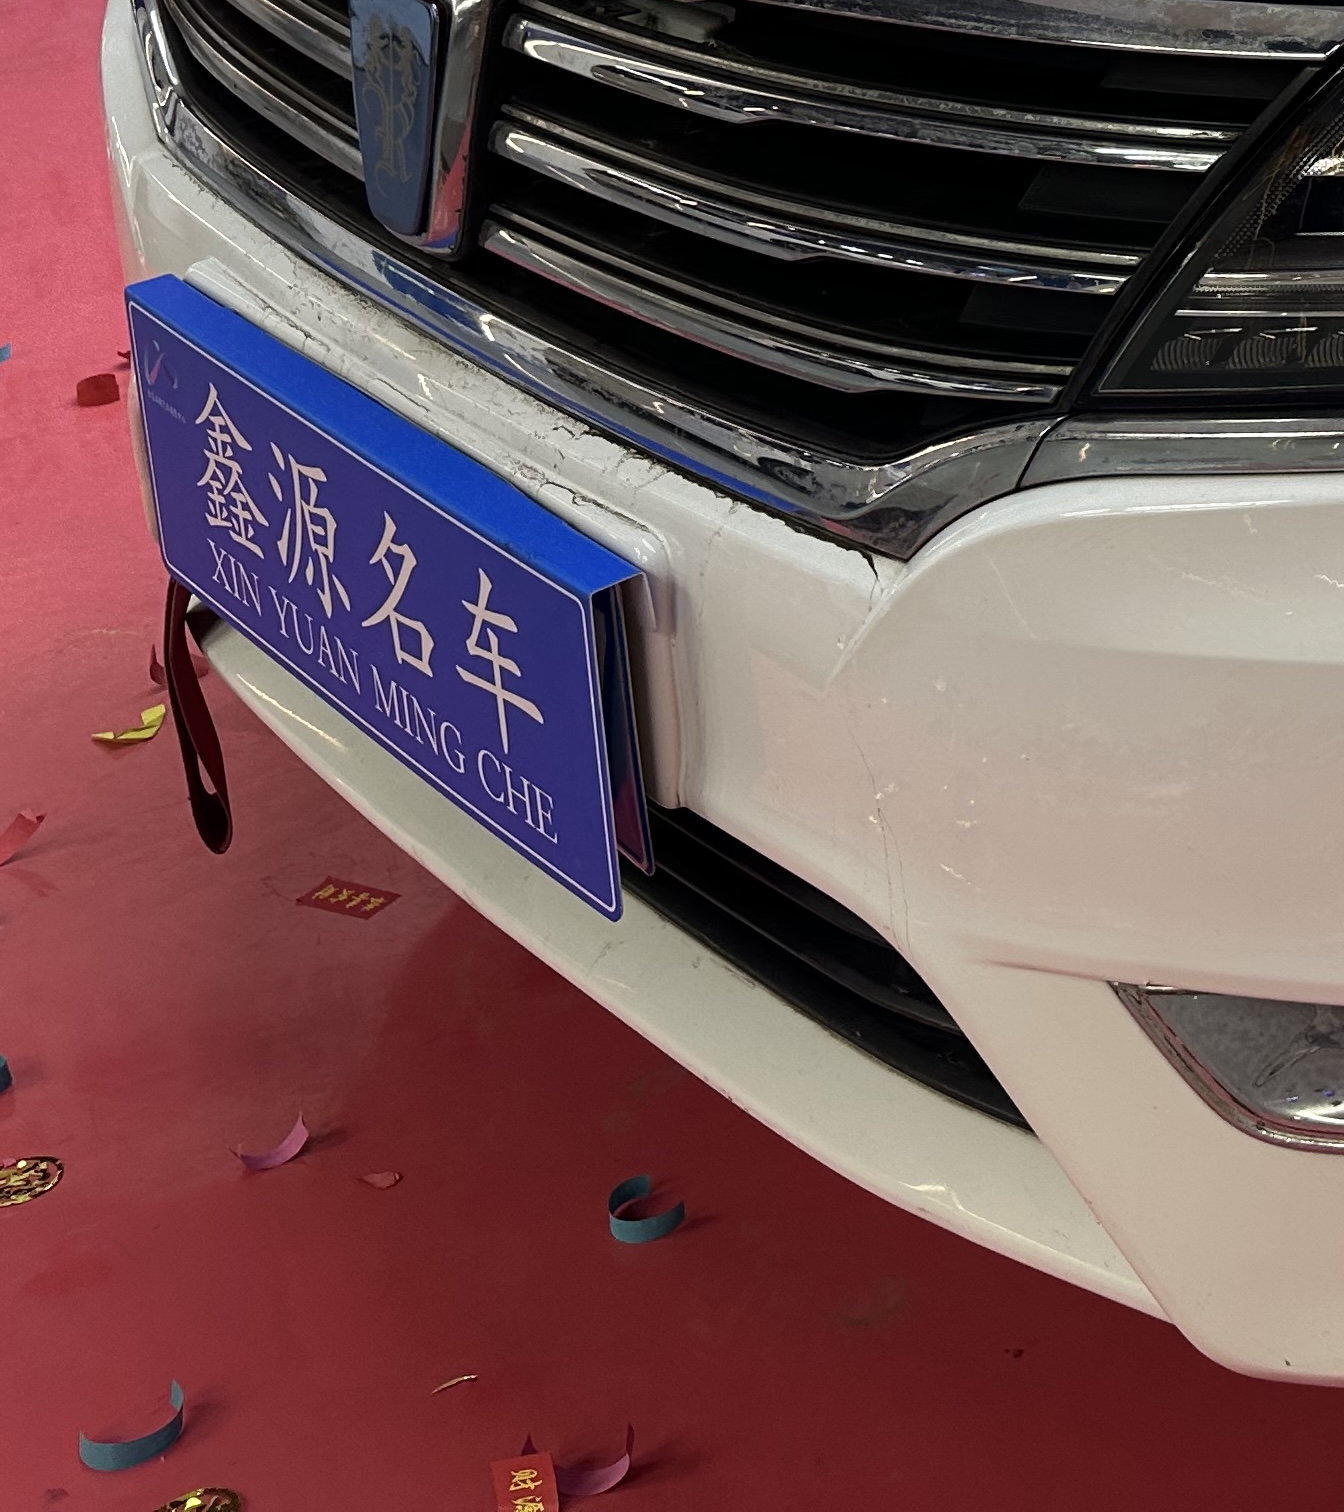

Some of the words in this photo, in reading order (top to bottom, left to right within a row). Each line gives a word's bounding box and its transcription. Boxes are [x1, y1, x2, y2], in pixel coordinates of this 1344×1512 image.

[195, 382, 544, 754] 鑫源名车
[206, 538, 260, 618] XIN
[268, 583, 361, 696] YUAN
[372, 664, 466, 775] MING
[477, 748, 559, 845] CHE
